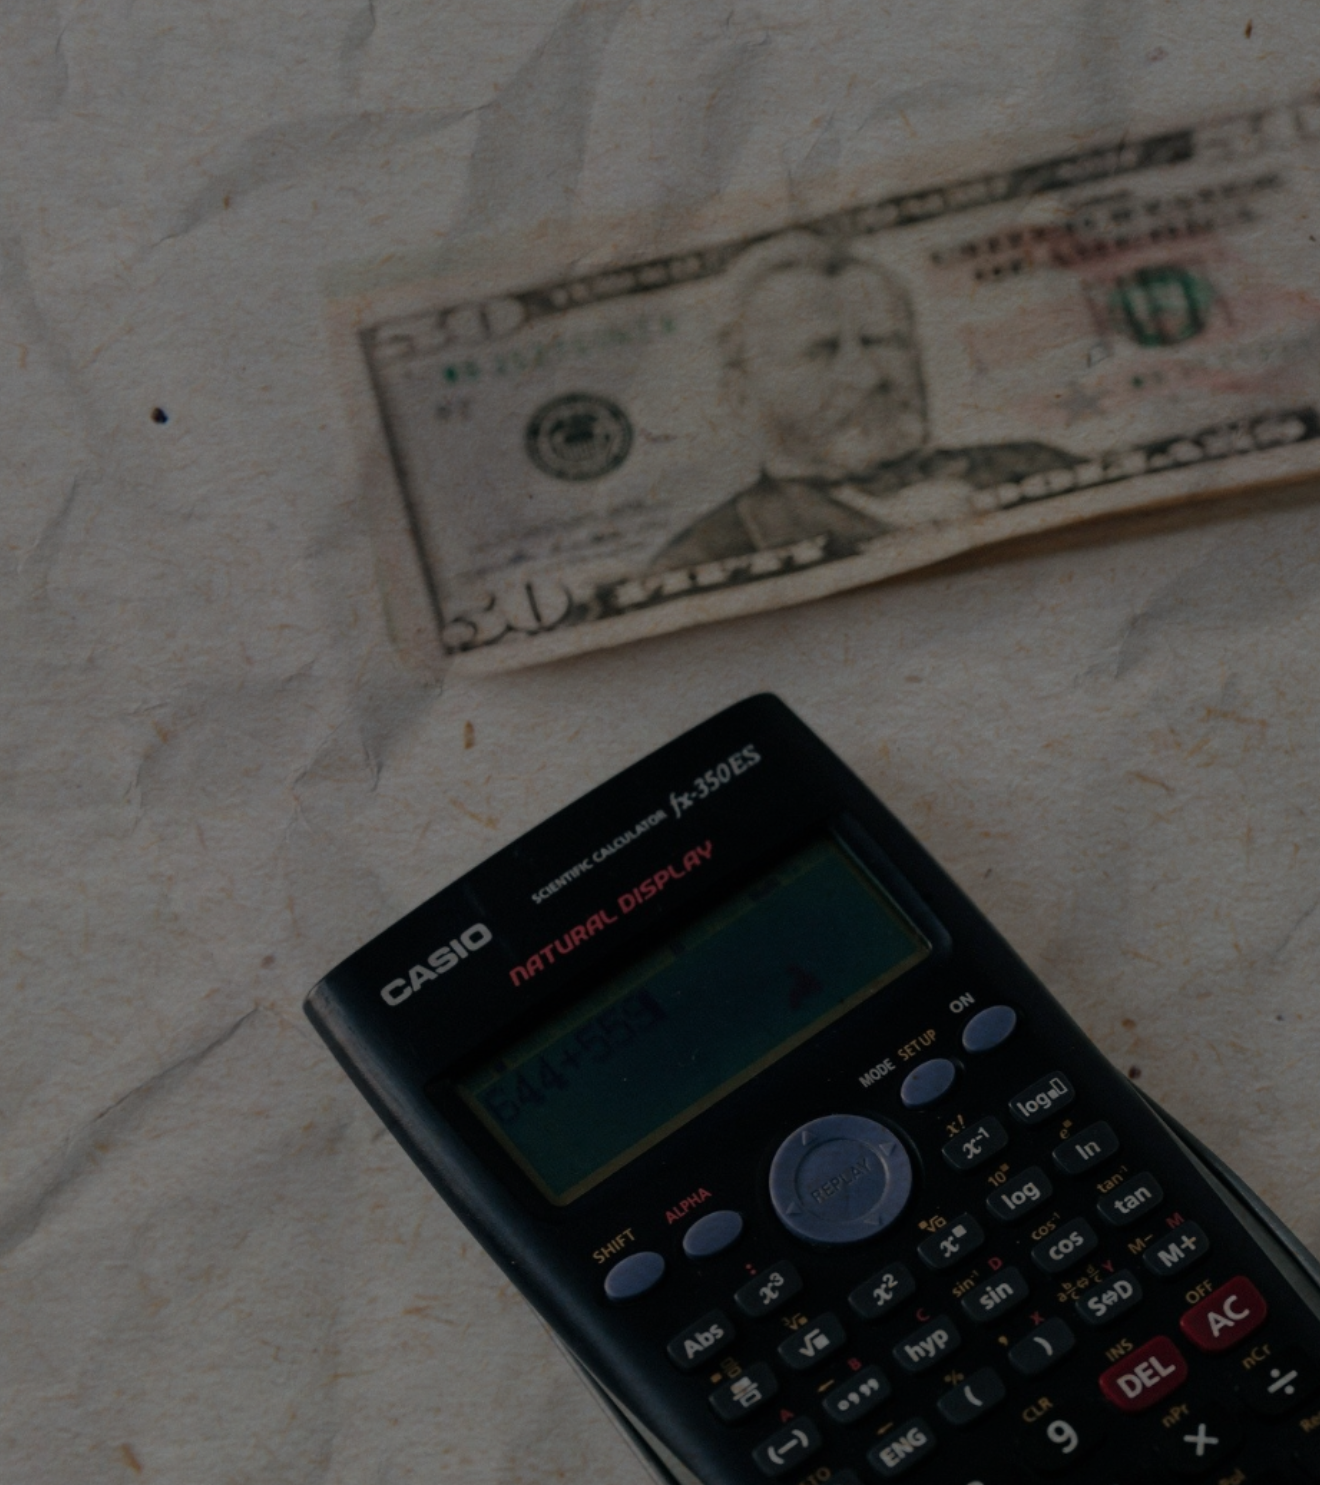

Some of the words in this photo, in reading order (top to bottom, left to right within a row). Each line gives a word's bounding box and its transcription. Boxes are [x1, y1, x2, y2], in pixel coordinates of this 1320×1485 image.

[531, 859, 594, 905] SCIENTIFIC
[592, 808, 668, 864] CALCULATOR
[667, 743, 762, 819] fx-350ES
[509, 908, 618, 987] NATURAL
[615, 838, 715, 914] DISPLAY
[380, 922, 494, 1007] CASIO
[949, 992, 976, 1015] ON
[858, 1057, 897, 1088] MODE
[810, 1158, 871, 1205] REPLAY
[1000, 1180, 1039, 1212] log
[663, 1186, 713, 1225] ALPHA
[1113, 1184, 1153, 1215] tan
[592, 1227, 636, 1264] SHIFT
[1048, 1230, 1085, 1261] cos
[1157, 1235, 1197, 1268] M+
[987, 1256, 1003, 1271] D
[979, 1282, 1014, 1310] sin
[1185, 1278, 1214, 1305] OFF
[915, 1307, 931, 1322] C
[1206, 1295, 1251, 1338] AC
[682, 1323, 724, 1359] Abs
[903, 1329, 949, 1362] hyp
[1105, 1337, 1135, 1362] INS
[1241, 1343, 1272, 1370] nCr
[1116, 1356, 1176, 1399] DEL
[1021, 1396, 1055, 1424] CLR
[878, 1427, 928, 1468] ENG
[1046, 1419, 1079, 1454] 9
[799, 1465, 832, 1485] TO
